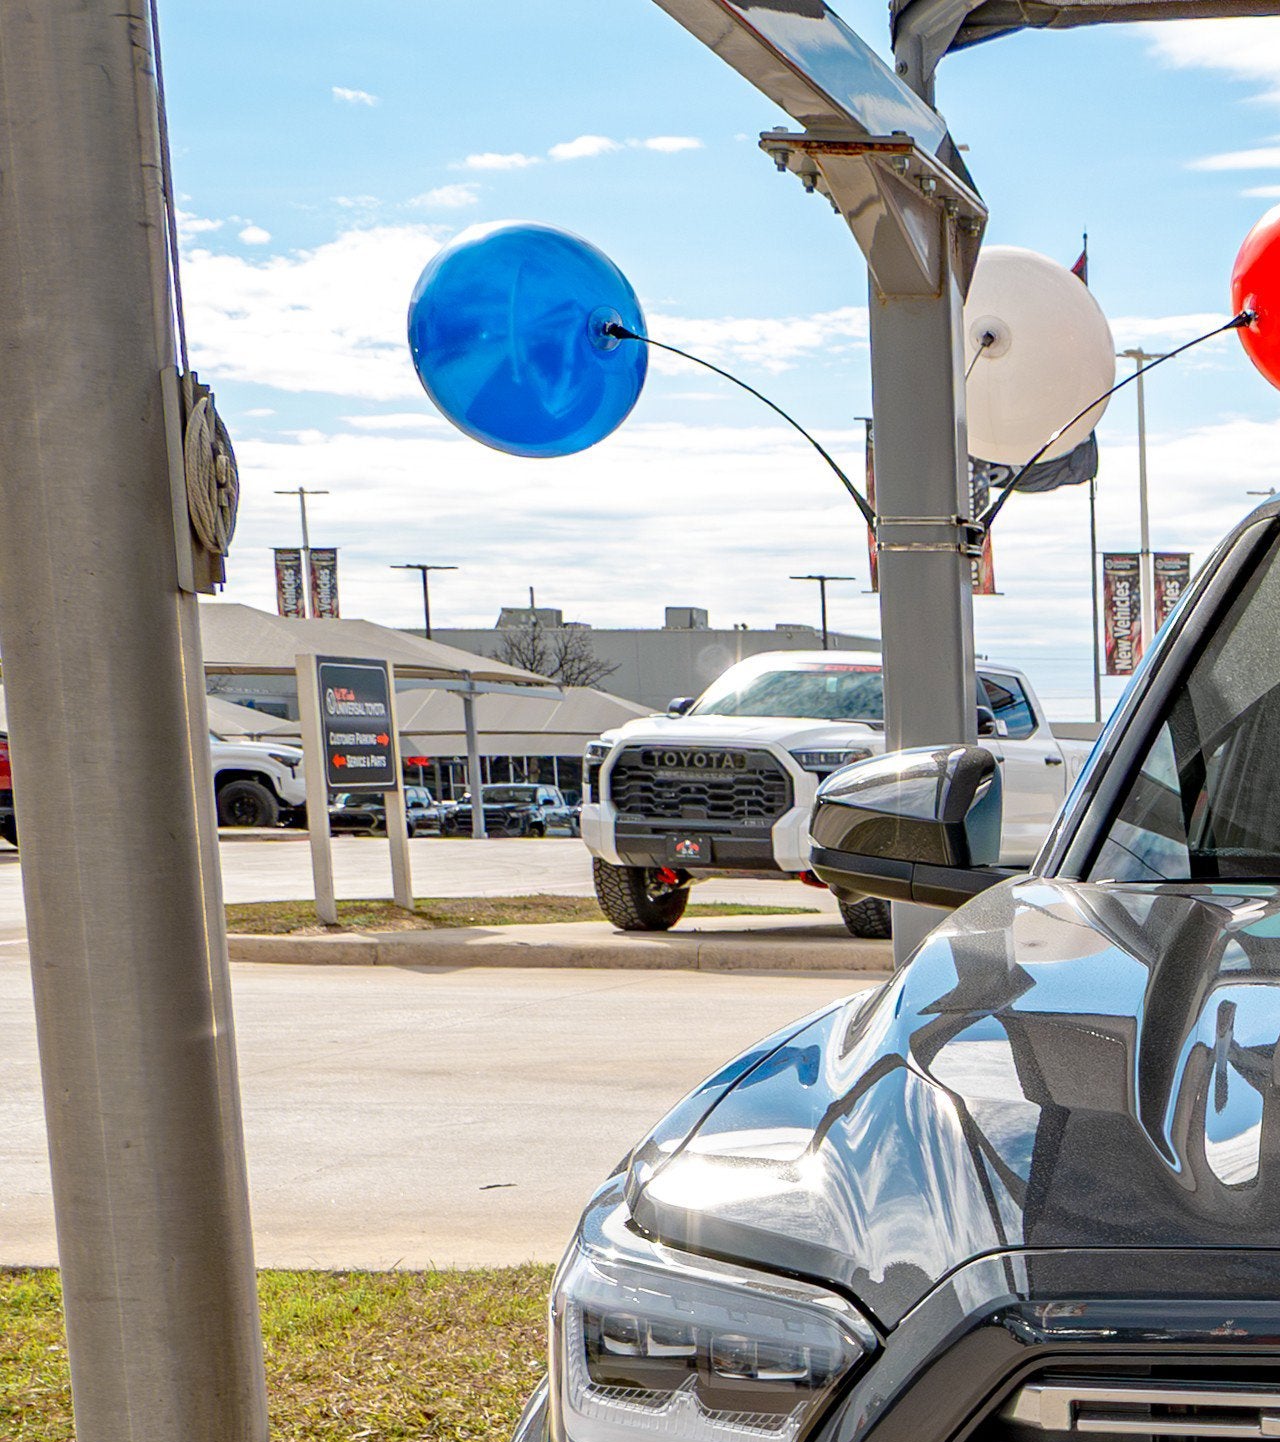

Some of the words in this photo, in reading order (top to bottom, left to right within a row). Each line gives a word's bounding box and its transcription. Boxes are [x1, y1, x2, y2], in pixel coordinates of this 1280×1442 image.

[1112, 581, 1131, 639] Vehicles
[1114, 640, 1132, 671] New
[651, 751, 735, 768] TOYOTA
